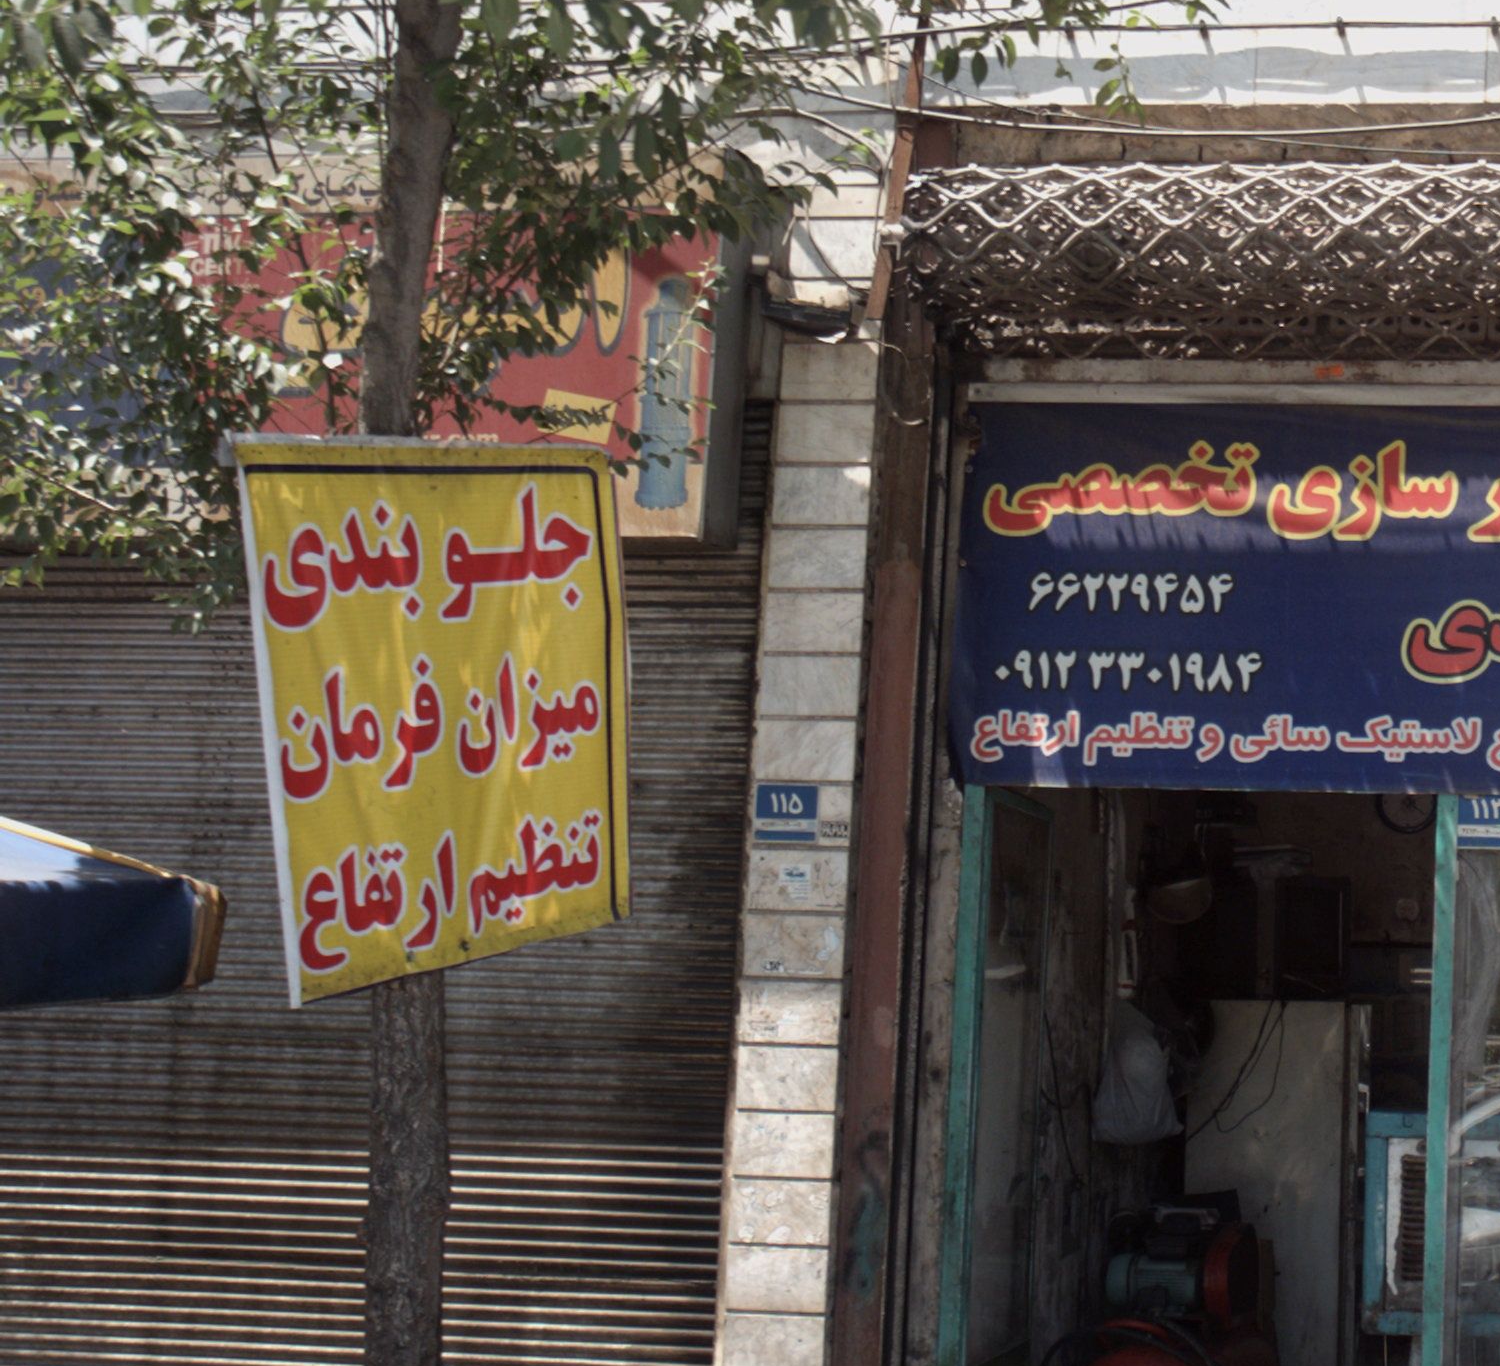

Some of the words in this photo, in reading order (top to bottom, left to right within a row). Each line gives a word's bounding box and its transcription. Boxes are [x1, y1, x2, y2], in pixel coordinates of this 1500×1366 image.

[983, 440, 1260, 537] تخصصی
[1267, 439, 1458, 541] سازی
[1028, 571, 1233, 614] ۶۶۲۲۹۴۵۴
[278, 653, 446, 803] فرمان
[456, 651, 602, 777] میزان
[970, 709, 1080, 763] ارتفاع
[1083, 712, 1194, 766] تنظیم
[1230, 713, 1329, 763] سائی
[1336, 714, 1482, 763] لاستیک
[1197, 720, 1225, 763] و
[771, 792, 804, 814] ۱۱۵
[467, 810, 602, 936] تنظیم
[297, 829, 458, 974] ارتفاع
